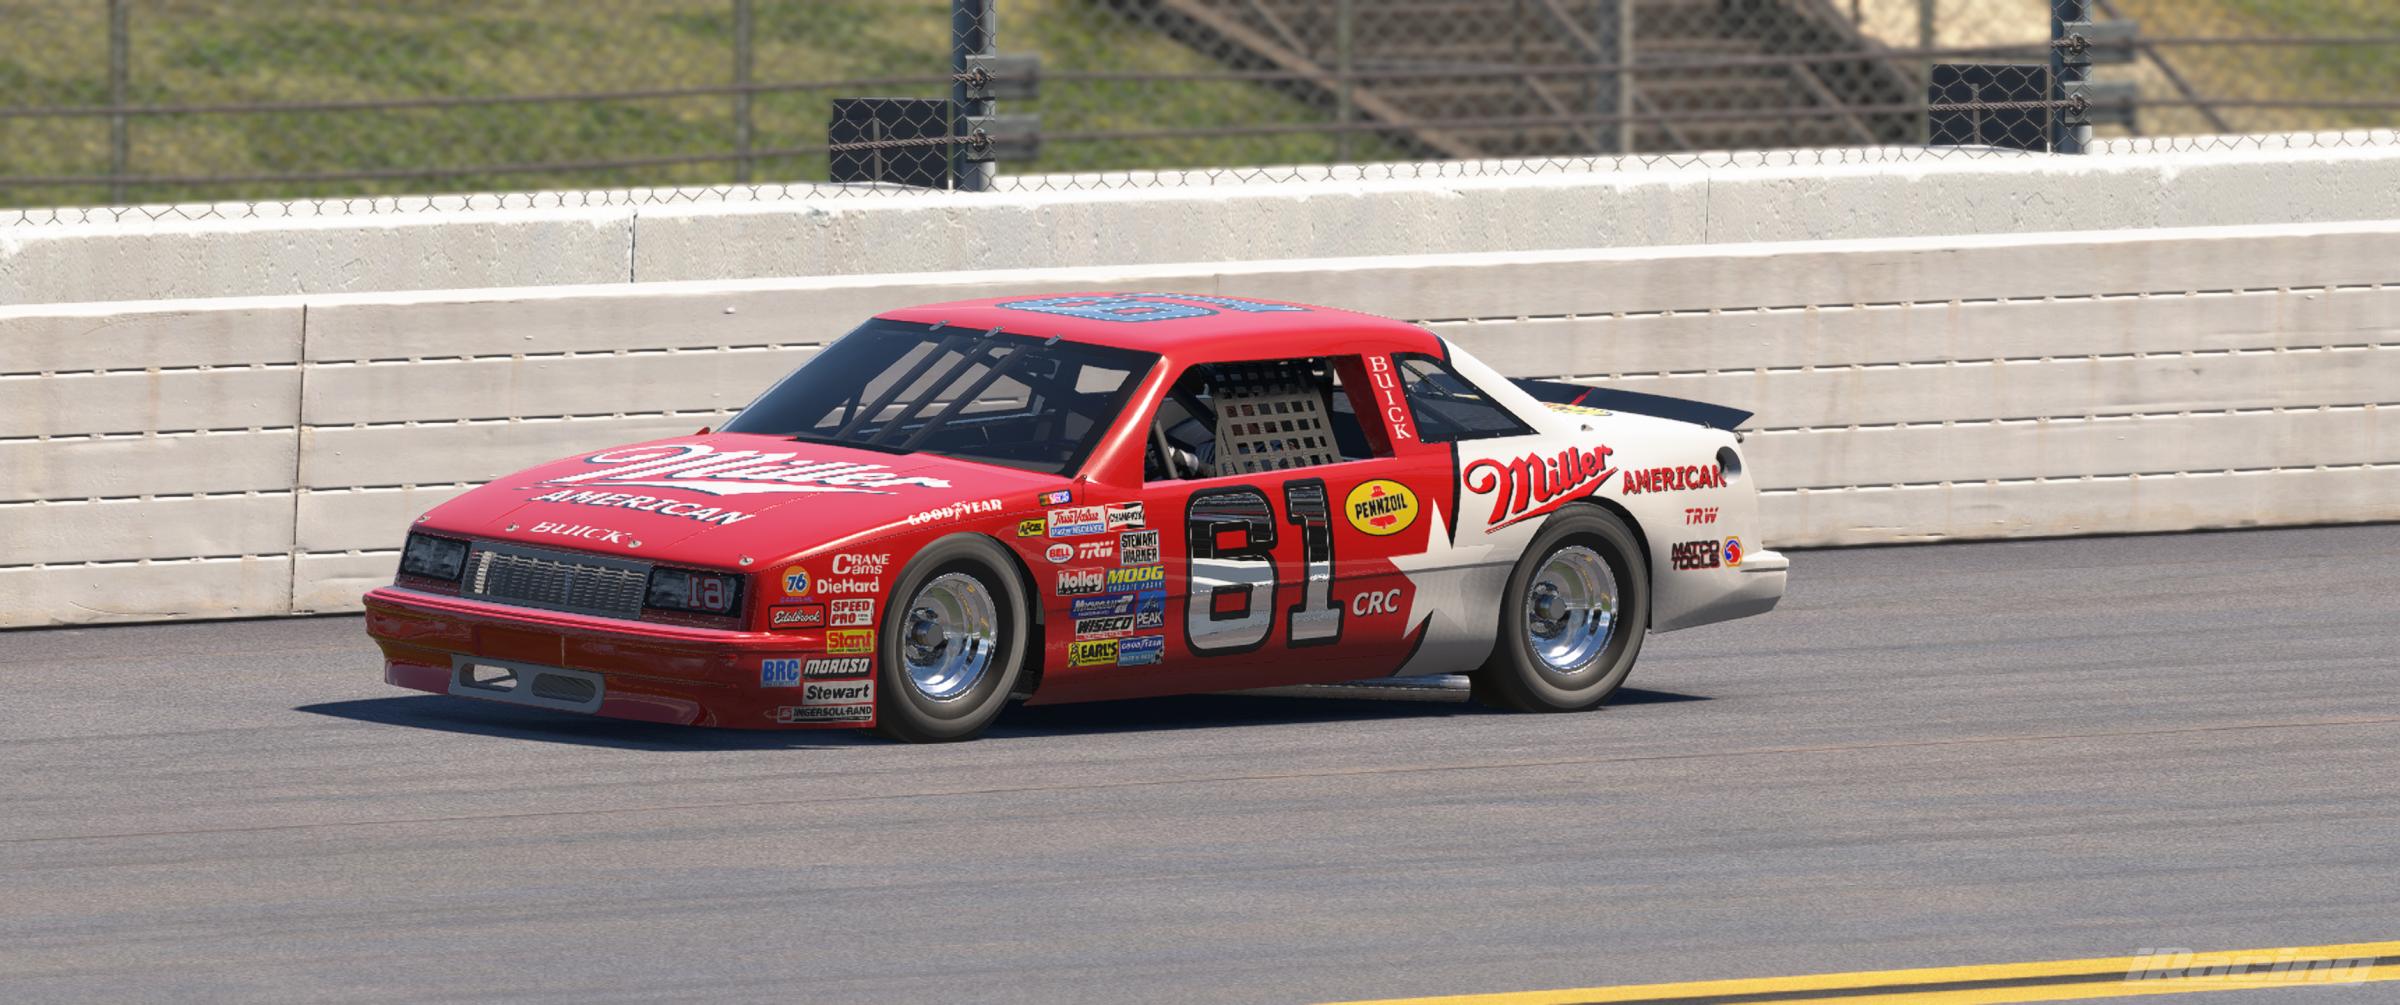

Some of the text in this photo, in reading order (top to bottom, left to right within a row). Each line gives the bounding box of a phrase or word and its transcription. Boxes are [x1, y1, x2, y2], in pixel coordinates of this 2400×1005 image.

[1368, 355, 1412, 440] BUICK
[535, 444, 953, 497] Miller
[1462, 444, 1618, 535] Miller
[530, 488, 756, 527] AMERICAN
[906, 499, 1003, 526] GOODYEAR
[1354, 494, 1409, 520] PENNZOIL
[1684, 507, 1719, 525] TRW
[1054, 508, 1099, 526] True Value
[530, 521, 633, 545] BUICK
[1121, 532, 1158, 549] STEWART
[1049, 548, 1070, 558] BELL
[1078, 541, 1114, 560] TRW
[1122, 547, 1158, 563] WARNER
[1671, 540, 1720, 557] MATCO
[1184, 477, 1345, 657] 61
[1671, 555, 1720, 570] TOOLS
[786, 572, 808, 592] 76
[1058, 569, 1103, 592] Holley
[1107, 565, 1164, 585] MOOG
[816, 577, 880, 595] DieHard
[832, 600, 870, 613] SPEED
[1352, 588, 1401, 617] CRC
[831, 613, 857, 625] PRO
[1077, 617, 1133, 634] WISECO
[1137, 611, 1162, 625] PEAK
[828, 630, 873, 649] Stant
[1081, 643, 1118, 657] EARL'S
[763, 659, 800, 682] BRC
[804, 657, 870, 675] MOROSO
[806, 683, 870, 701] Stewart
[794, 706, 873, 717] INGERSOLL-RAND
